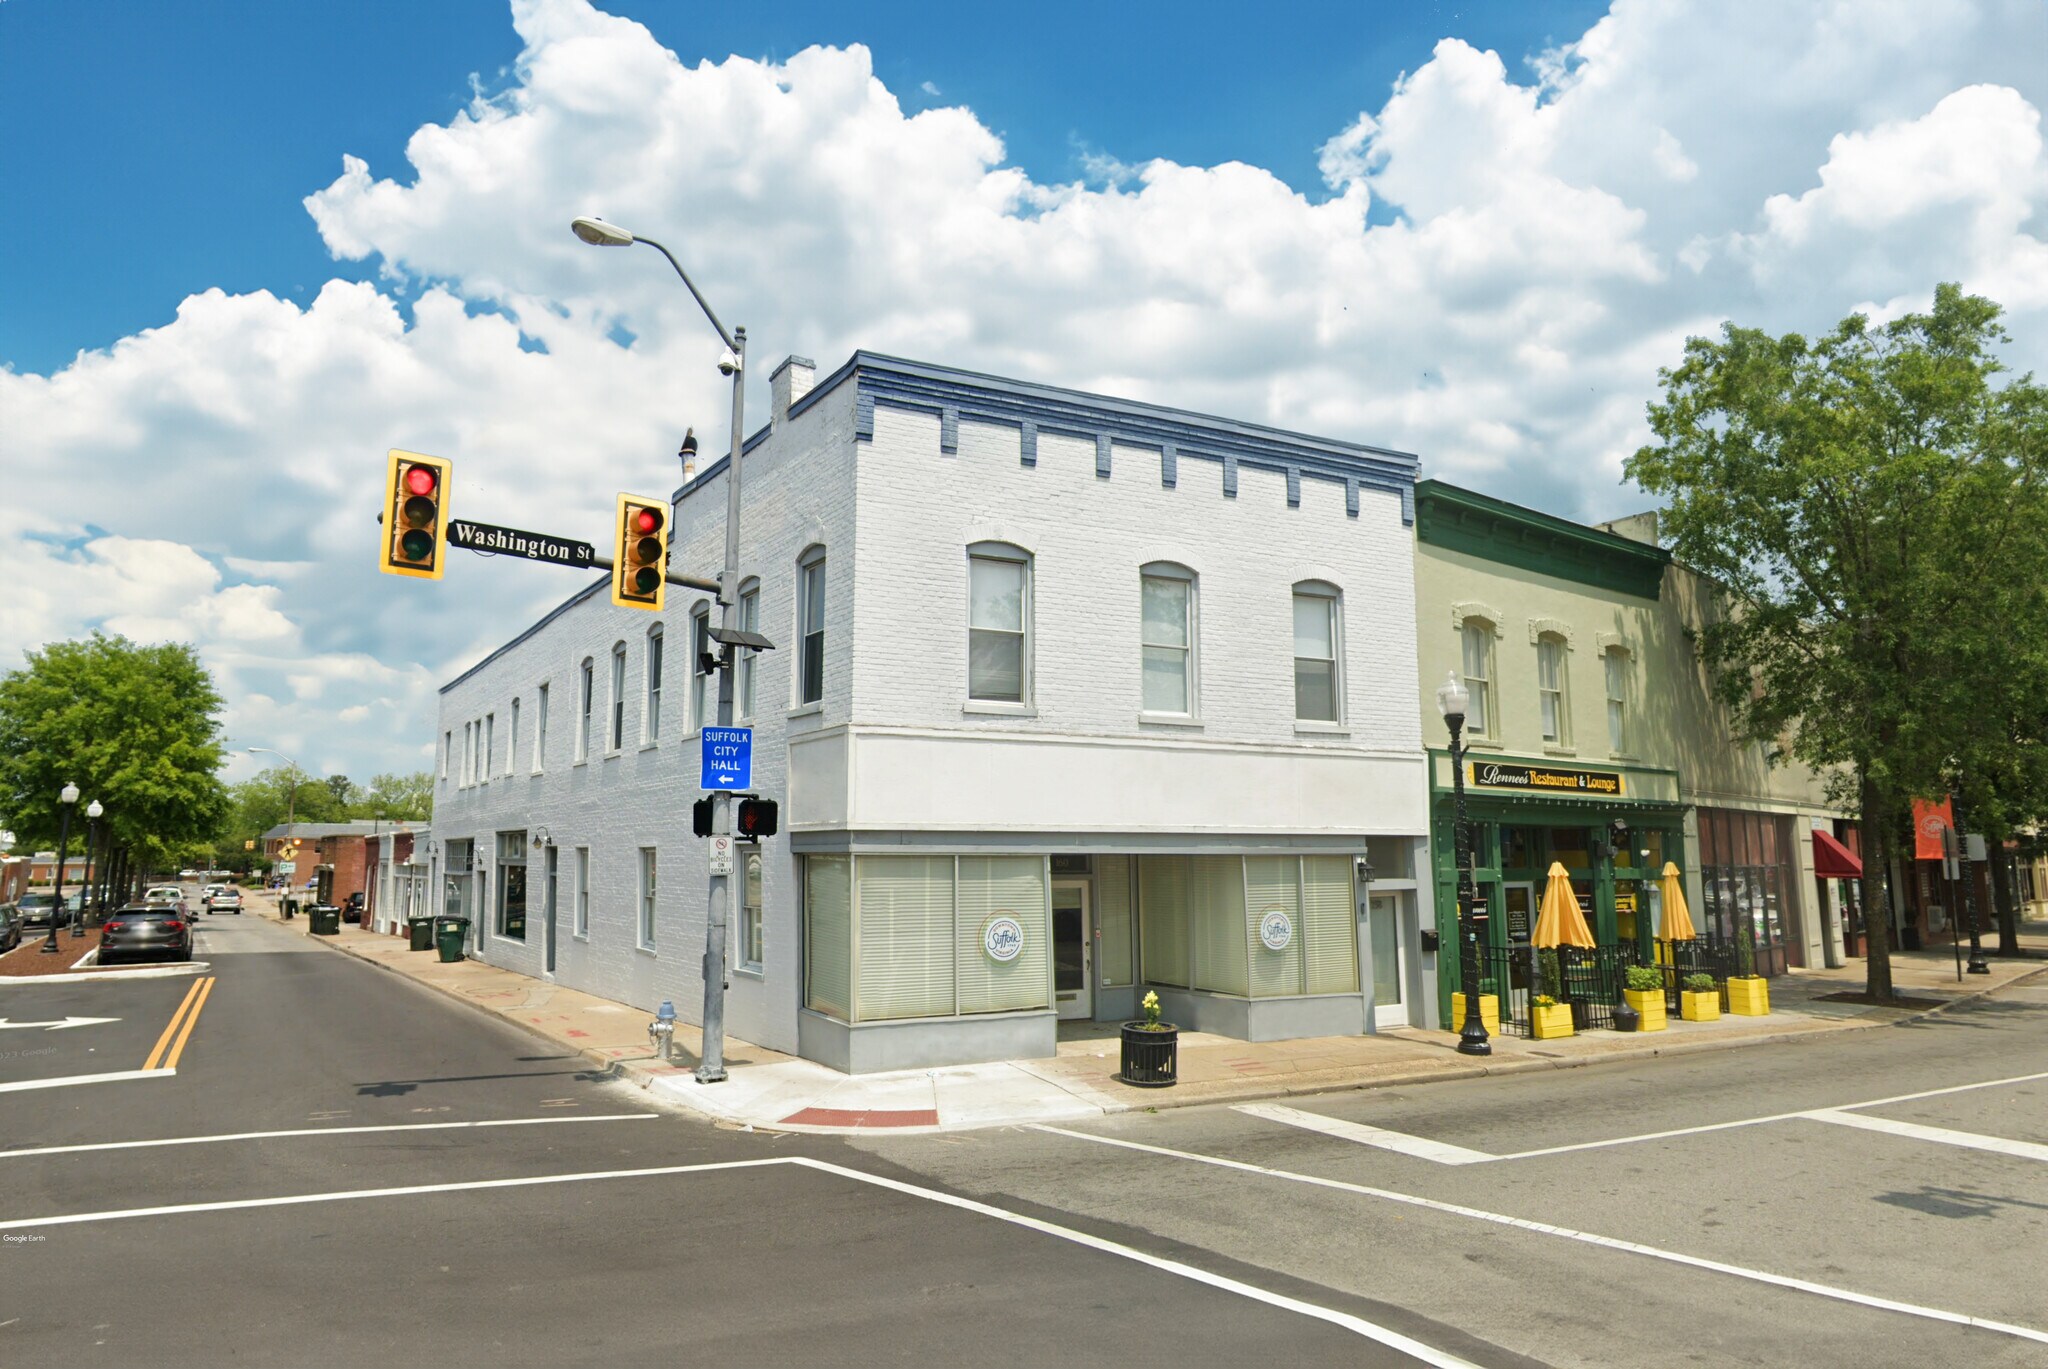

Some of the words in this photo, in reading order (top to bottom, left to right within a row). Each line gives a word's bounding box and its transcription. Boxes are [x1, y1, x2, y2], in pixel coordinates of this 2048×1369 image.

[456, 523, 569, 559] Washington
[576, 546, 590, 560] St
[705, 731, 748, 743] SUFFOLK
[714, 746, 739, 756] CITY
[711, 760, 741, 771] HALL
[1480, 765, 1529, 784] Rennee's
[1529, 770, 1578, 787] Restaurant
[1579, 776, 1585, 787] &
[1587, 775, 1616, 791] Lounge
[988, 930, 1020, 950] Suffolk
[1263, 923, 1290, 940] Suffolk
